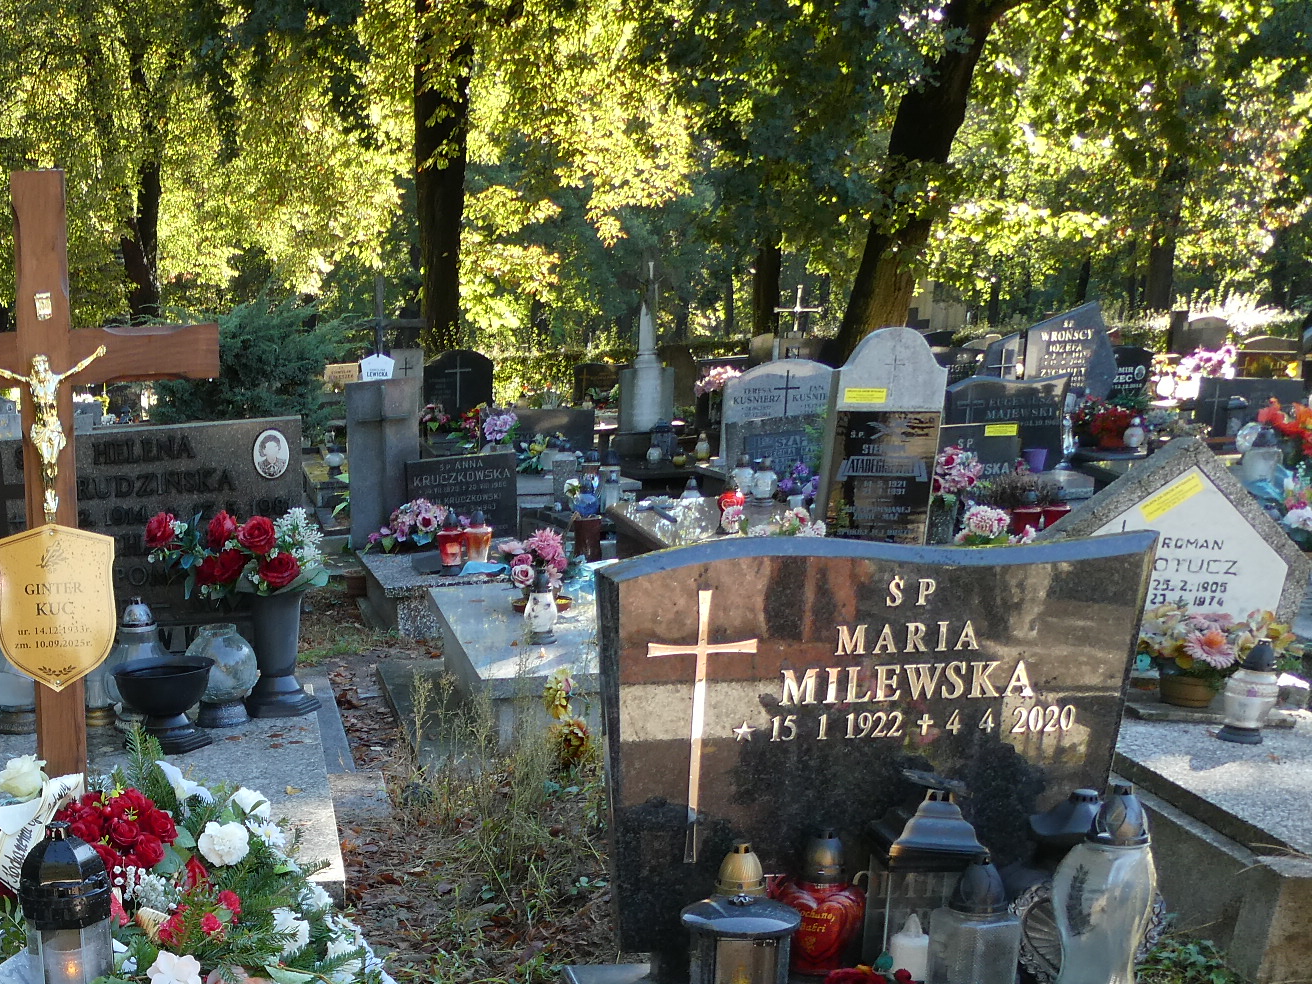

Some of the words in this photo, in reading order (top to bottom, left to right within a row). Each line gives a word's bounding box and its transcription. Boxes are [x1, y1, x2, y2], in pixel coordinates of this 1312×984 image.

[93, 435, 196, 466] HELENA
[454, 459, 484, 470] ANNA
[413, 468, 511, 487] KRUCZKOWSKA
[444, 493, 502, 504] KRUCZKOWSKI
[1161, 537, 1225, 551] ROMAN
[1153, 557, 1239, 577] OTUCZ
[24, 581, 84, 596] GINTER
[1196, 581, 1229, 593] 1905
[17, 626, 31, 636] ur.
[834, 620, 980, 657] MARIA
[14, 640, 32, 650] zm.
[34, 639, 93, 649] 10.09.2025r.
[778, 660, 1035, 708] MILEWSKA
[769, 715, 798, 743] 15
[817, 716, 827, 740] 1
[845, 710, 904, 738] 1922
[944, 708, 962, 734] 4
[977, 707, 996, 732] 4
[1011, 704, 1077, 734] 2020
